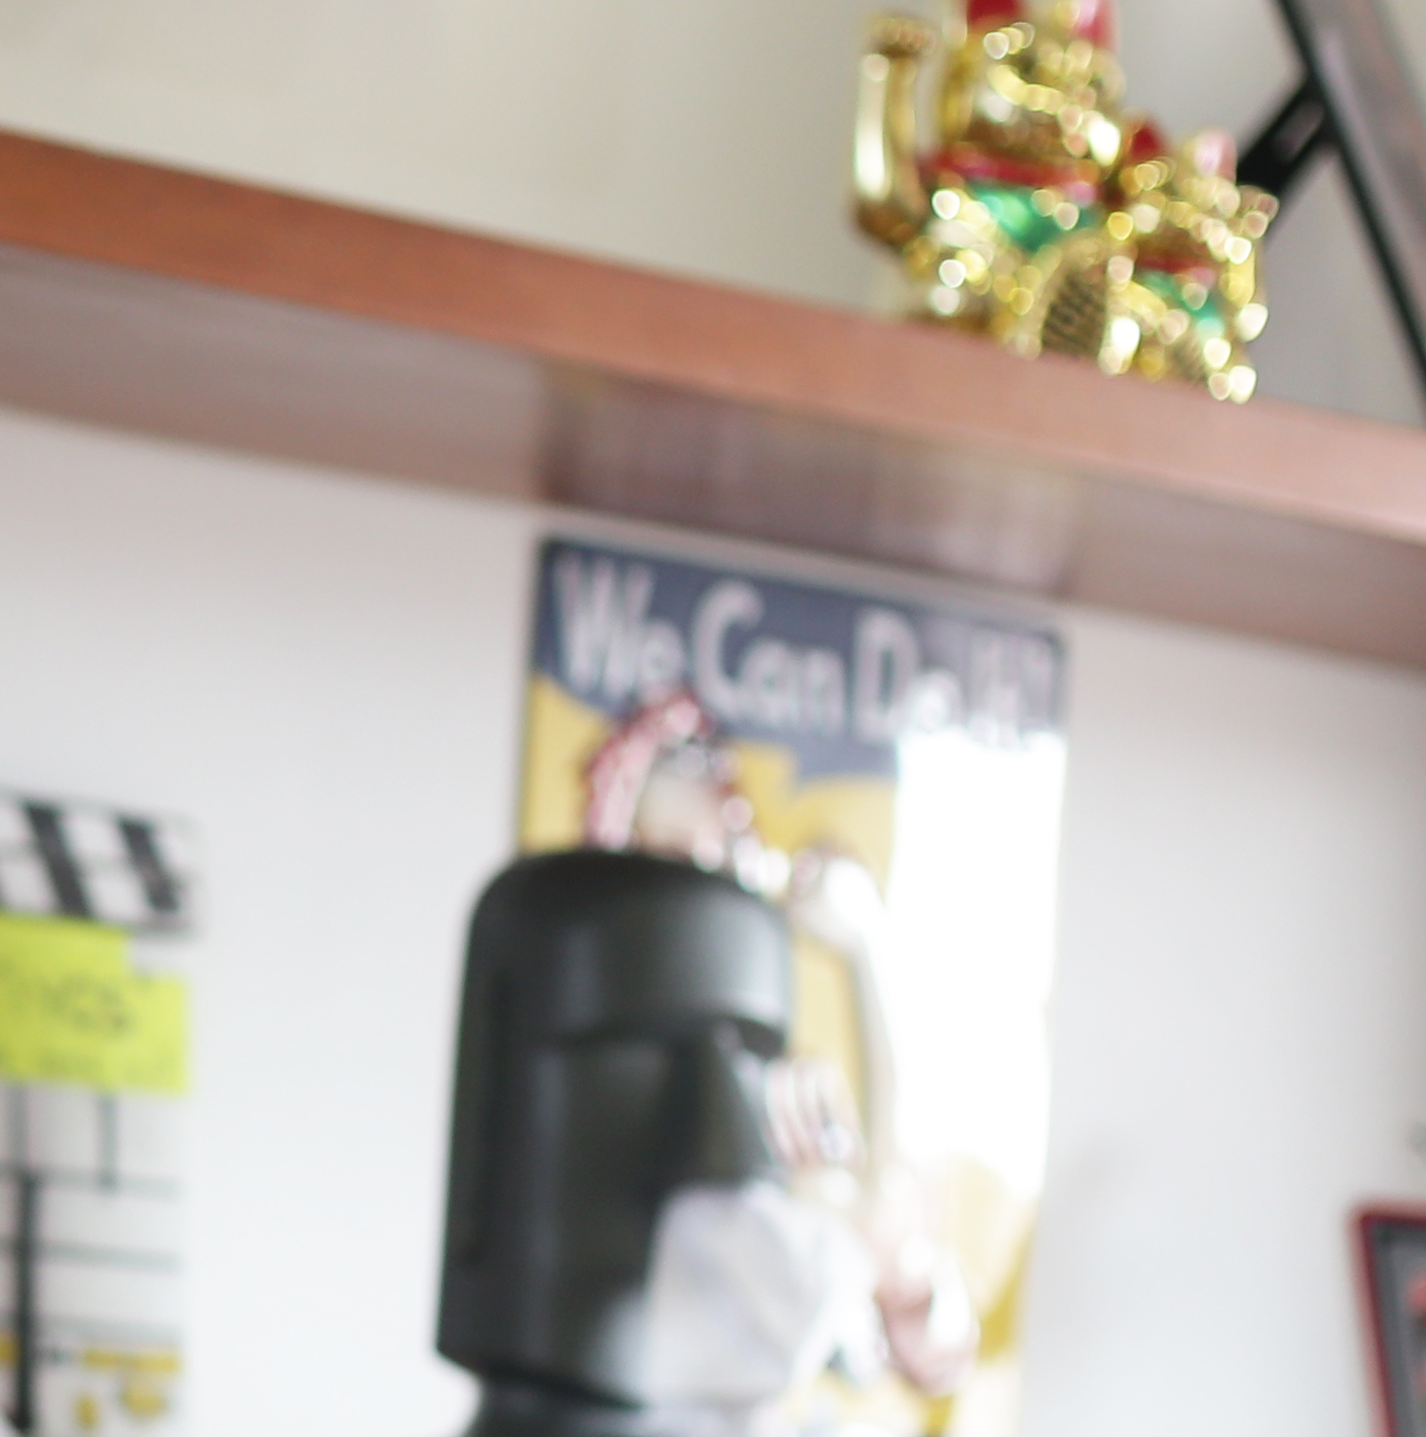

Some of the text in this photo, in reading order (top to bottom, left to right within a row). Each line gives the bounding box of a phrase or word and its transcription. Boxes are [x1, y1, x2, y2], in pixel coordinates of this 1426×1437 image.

[554, 552, 685, 703] We
[693, 578, 847, 736] Can
[852, 605, 964, 746] Do
